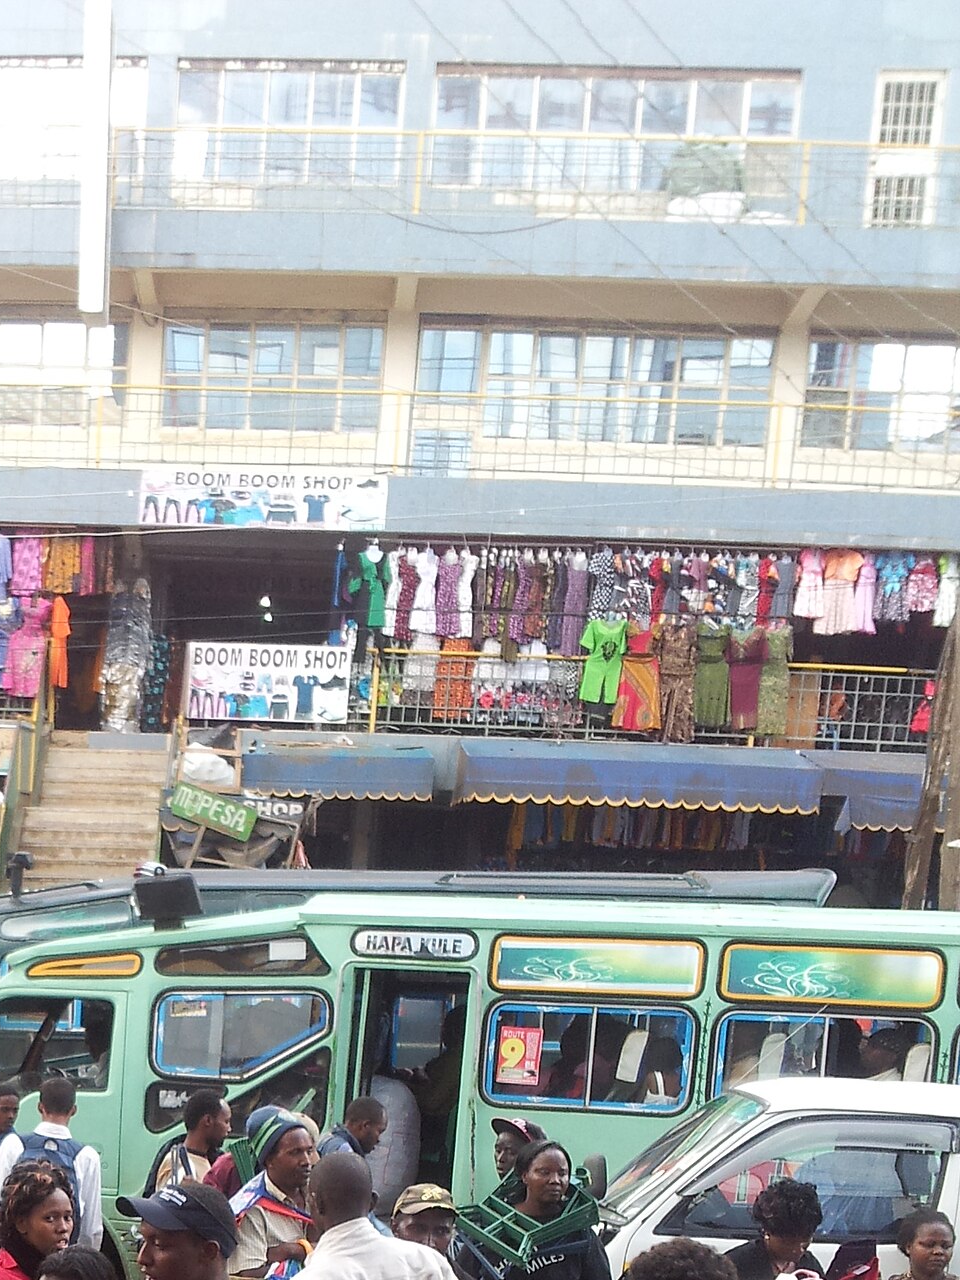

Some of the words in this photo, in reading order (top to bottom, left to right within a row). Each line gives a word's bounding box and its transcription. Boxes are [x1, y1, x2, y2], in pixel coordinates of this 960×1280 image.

[175, 471, 231, 487] BOOM
[239, 473, 295, 489] BOOM
[303, 475, 353, 490] SHOP
[194, 647, 242, 666] BOOM
[249, 648, 298, 668] BOOM
[304, 650, 347, 669] SHOP
[366, 935, 415, 952] HAPA
[419, 937, 463, 955] KULE
[503, 1030, 525, 1039] ROUTE
[500, 1037, 526, 1068] 9
[526, 1254, 565, 1275] MILES
